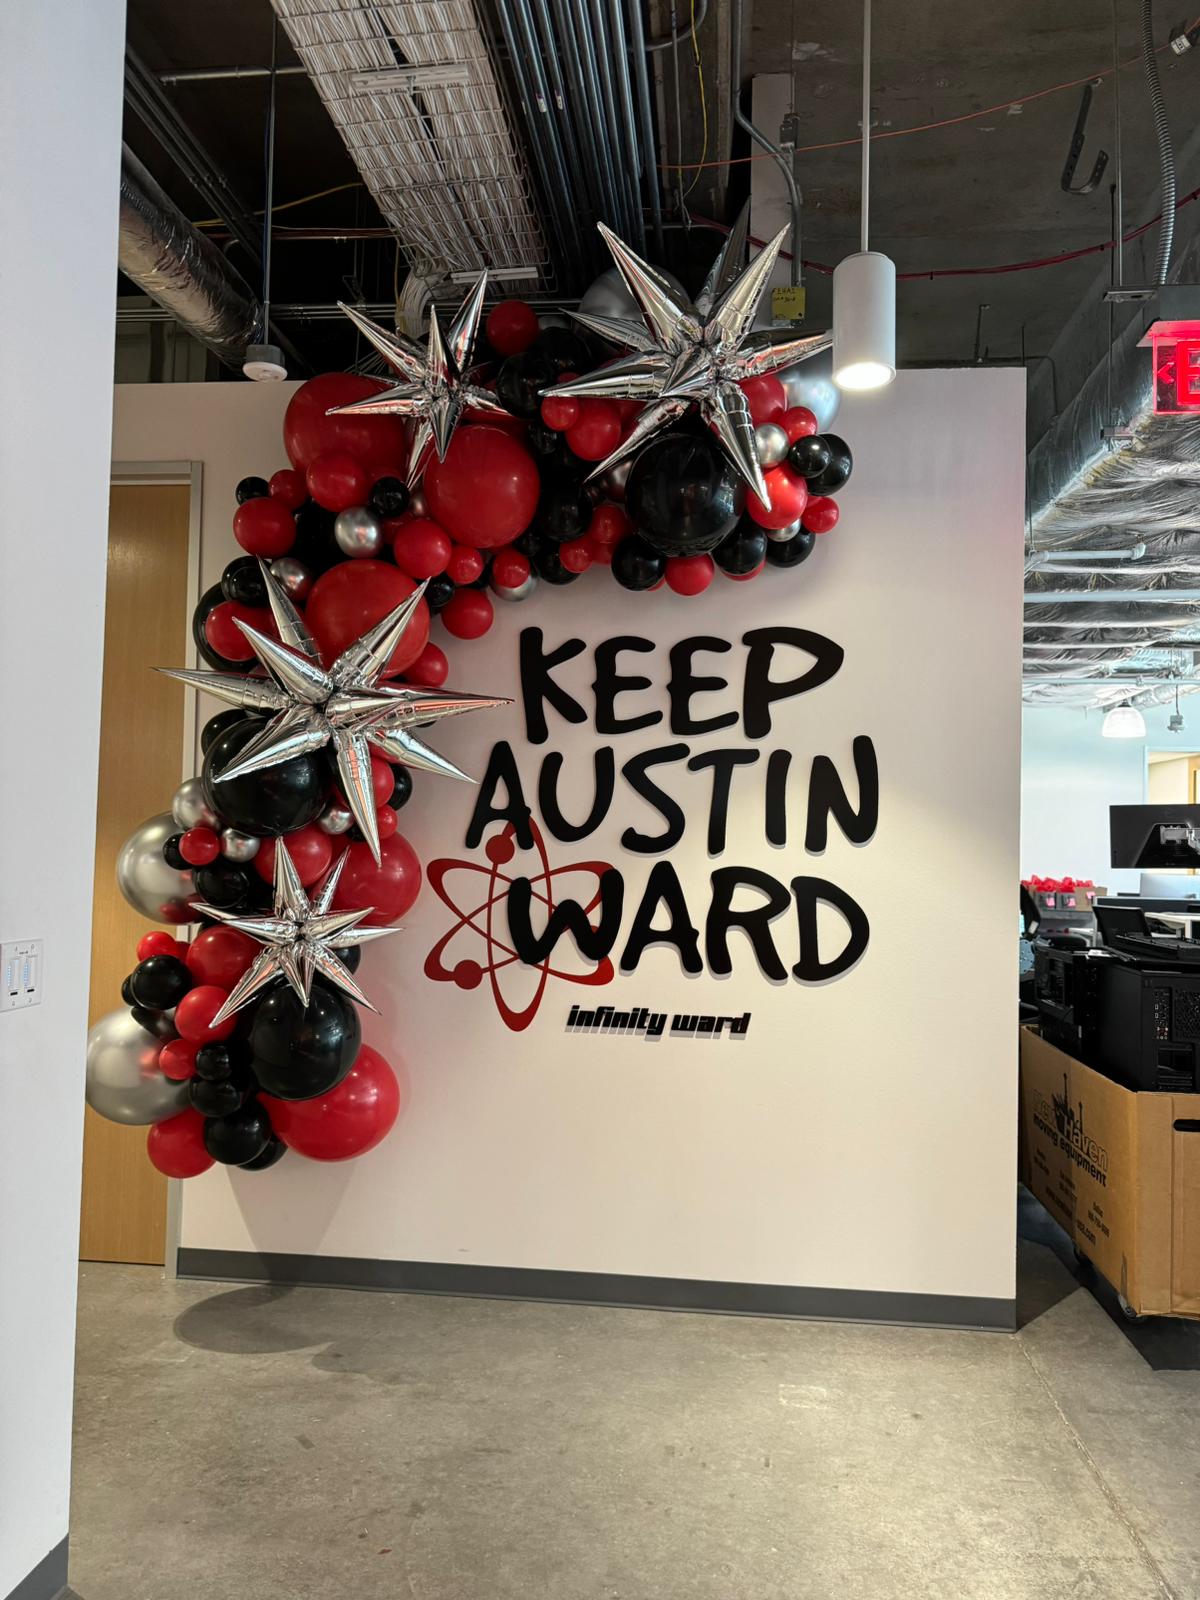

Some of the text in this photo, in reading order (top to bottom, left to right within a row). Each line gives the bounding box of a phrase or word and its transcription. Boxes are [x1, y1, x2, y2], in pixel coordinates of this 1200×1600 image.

[520, 627, 844, 744] KEEP
[465, 735, 879, 856] AUSTIN
[507, 861, 870, 981] WARD
[567, 1005, 752, 1036] infinity ward
[1060, 1137, 1107, 1187] equipment
